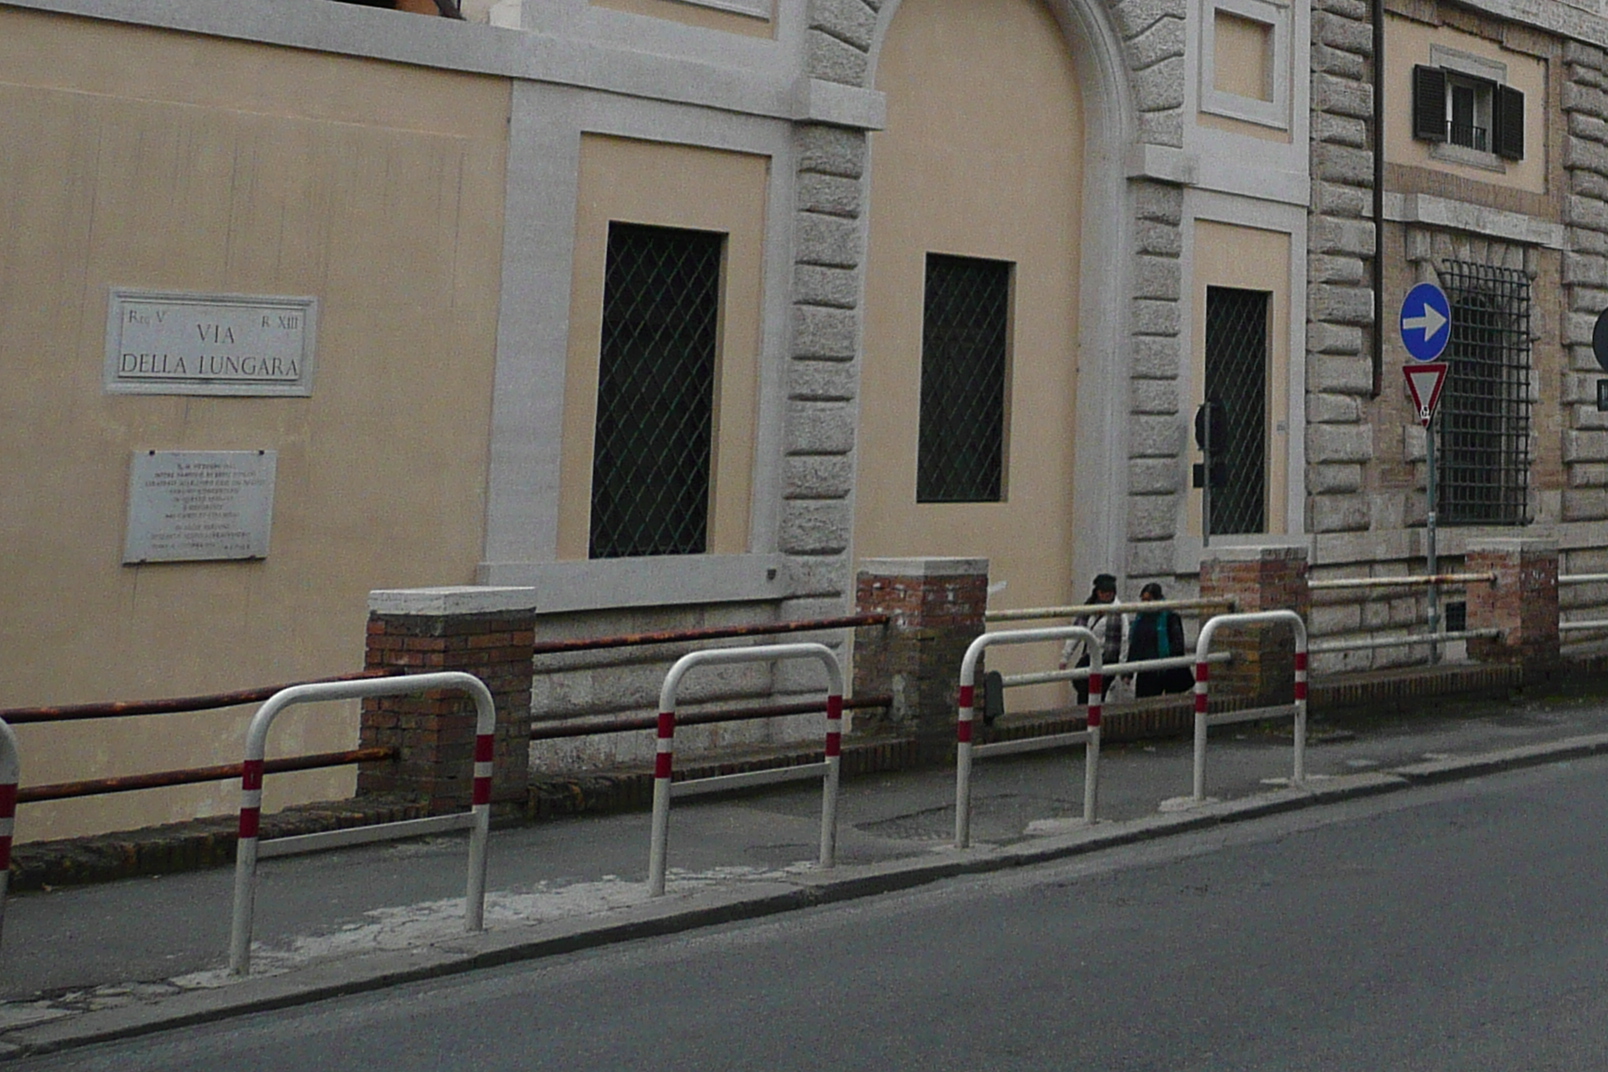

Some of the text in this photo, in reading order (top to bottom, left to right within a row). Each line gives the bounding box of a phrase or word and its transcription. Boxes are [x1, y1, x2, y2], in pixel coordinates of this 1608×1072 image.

[156, 311, 166, 323] V
[278, 316, 298, 329] XIII
[197, 323, 235, 344] VIA
[121, 353, 298, 376] DELLA LUNGARA
